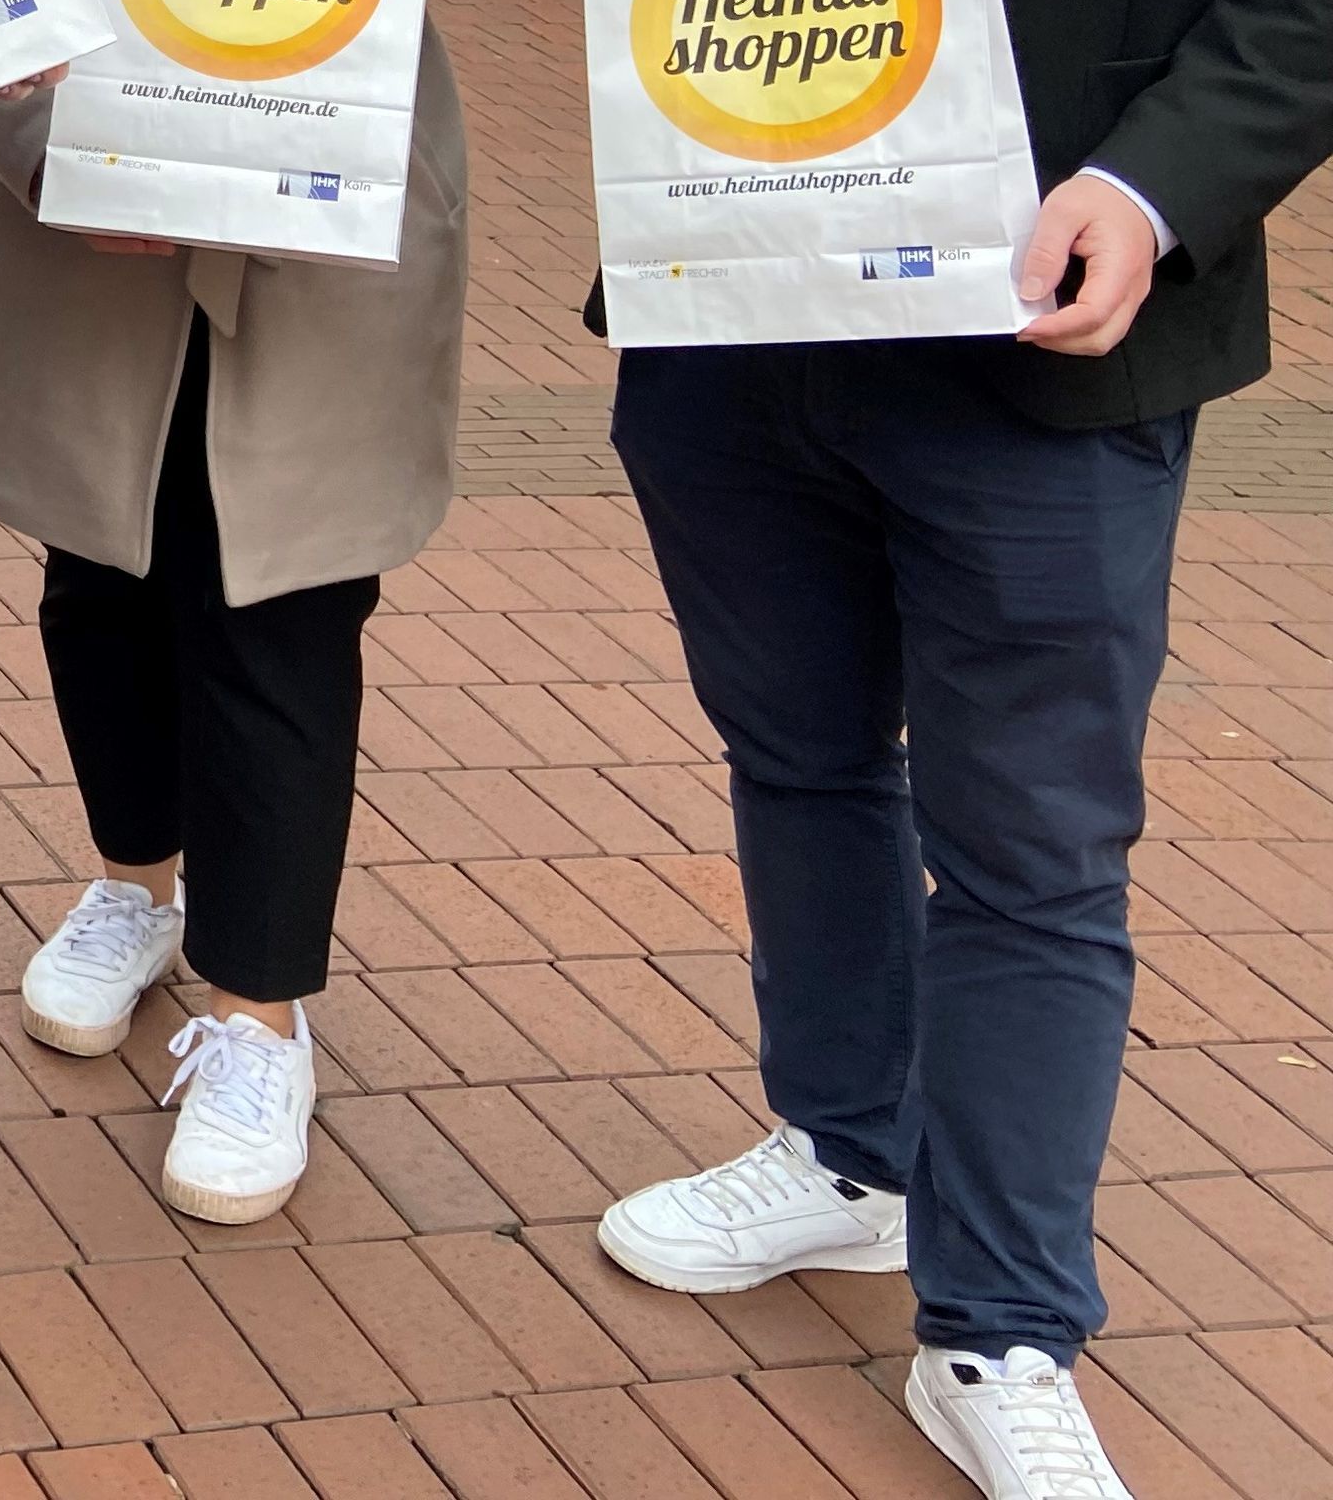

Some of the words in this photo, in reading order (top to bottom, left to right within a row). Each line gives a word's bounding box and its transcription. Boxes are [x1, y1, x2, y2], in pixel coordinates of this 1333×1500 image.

[664, 20, 906, 87] shoppen
[120, 82, 340, 119] www.heimatshoppen.de
[313, 176, 338, 189] IHK
[343, 179, 371, 192] Köln
[667, 167, 915, 199] www.heimatshoppen.de
[901, 249, 931, 263] IHK
[938, 247, 971, 261] Köln
